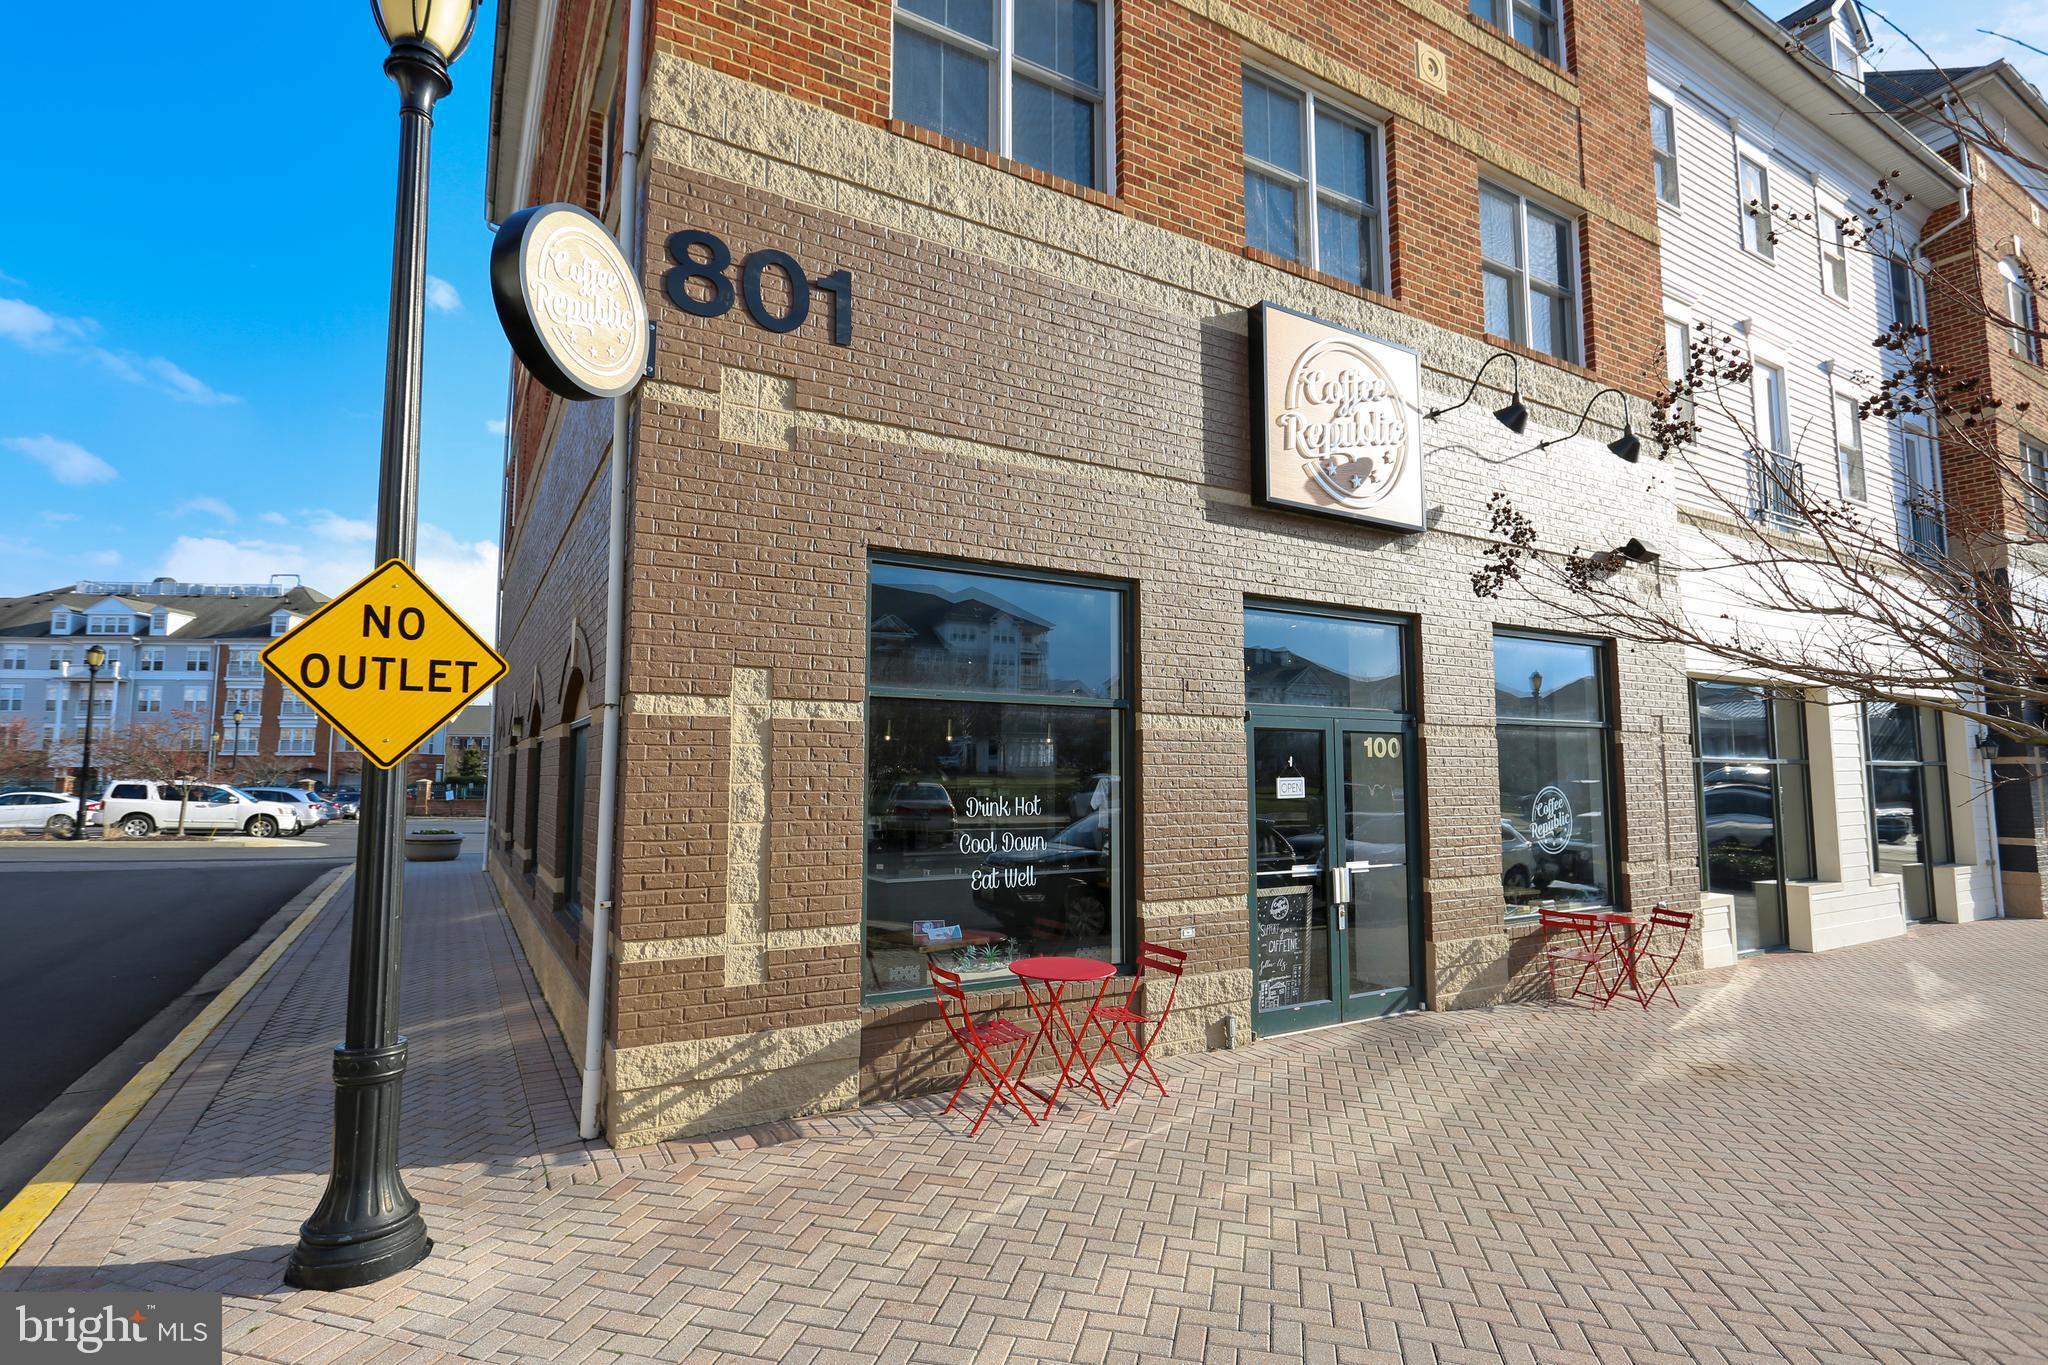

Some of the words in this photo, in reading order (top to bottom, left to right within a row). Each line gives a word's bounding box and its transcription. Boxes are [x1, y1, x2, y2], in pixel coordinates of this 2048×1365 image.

[548, 249, 620, 297] Coffee
[665, 228, 853, 347] 801
[530, 281, 634, 337] Republic
[1297, 367, 1388, 418] Coffee
[1275, 409, 1408, 463] Republic
[362, 603, 426, 641] NO
[300, 652, 479, 694] OUTLET
[1363, 735, 1402, 759] 100
[1280, 782, 1303, 794] OPEN
[965, 795, 1011, 818] Drink
[1015, 794, 1042, 817] Hot
[1535, 797, 1565, 820] Coffee
[1529, 811, 1571, 840] Republic
[959, 831, 998, 855] Cool
[1001, 831, 1048, 853] Down
[971, 867, 1000, 891] Eat
[1004, 865, 1037, 889] Well
